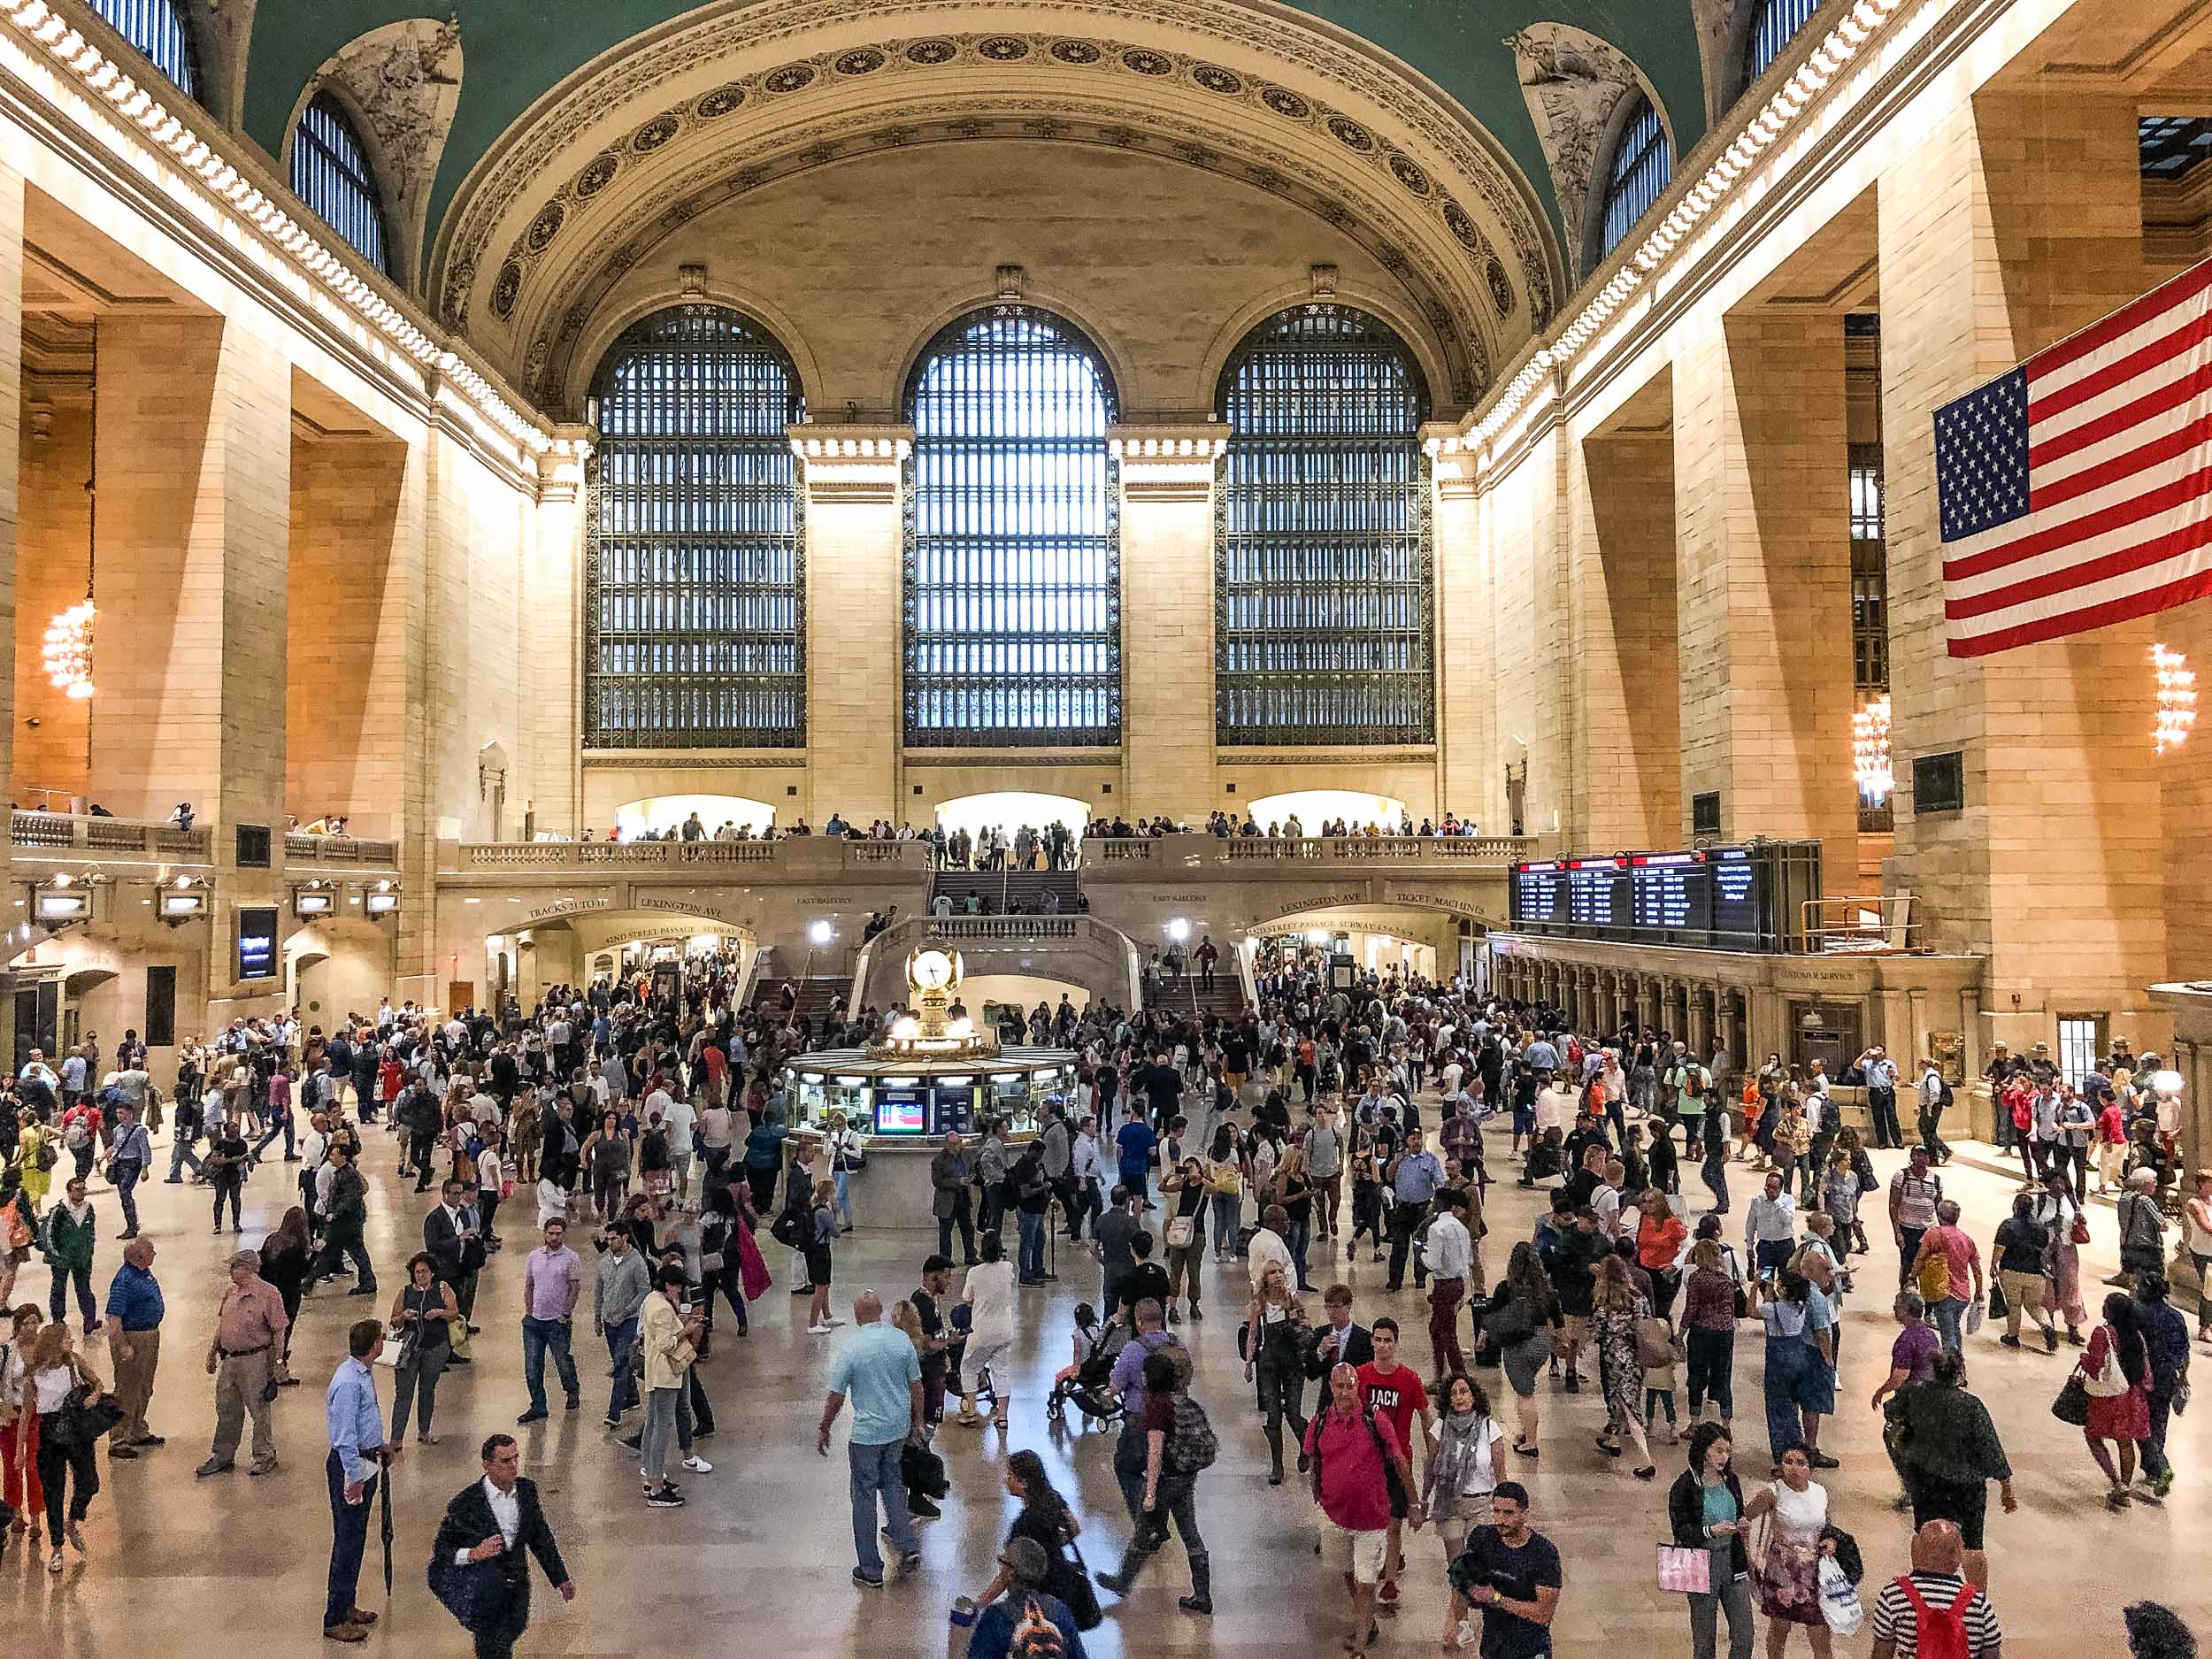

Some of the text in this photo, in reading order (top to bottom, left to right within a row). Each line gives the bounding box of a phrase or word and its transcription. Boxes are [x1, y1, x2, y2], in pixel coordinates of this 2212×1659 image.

[528, 904, 567, 918] TRACKS
[580, 899, 595, 909] TO
[641, 898, 722, 918] LEXINGTON AVE
[1280, 892, 1361, 913] LEXINGTON AVE
[1396, 893, 1486, 914] TICKET MACHINES
[628, 928, 657, 938] STREET
[660, 926, 694, 935] PASSAGE
[1339, 920, 1374, 930] SUBWAY
[1370, 1388, 1399, 1408] JACK
